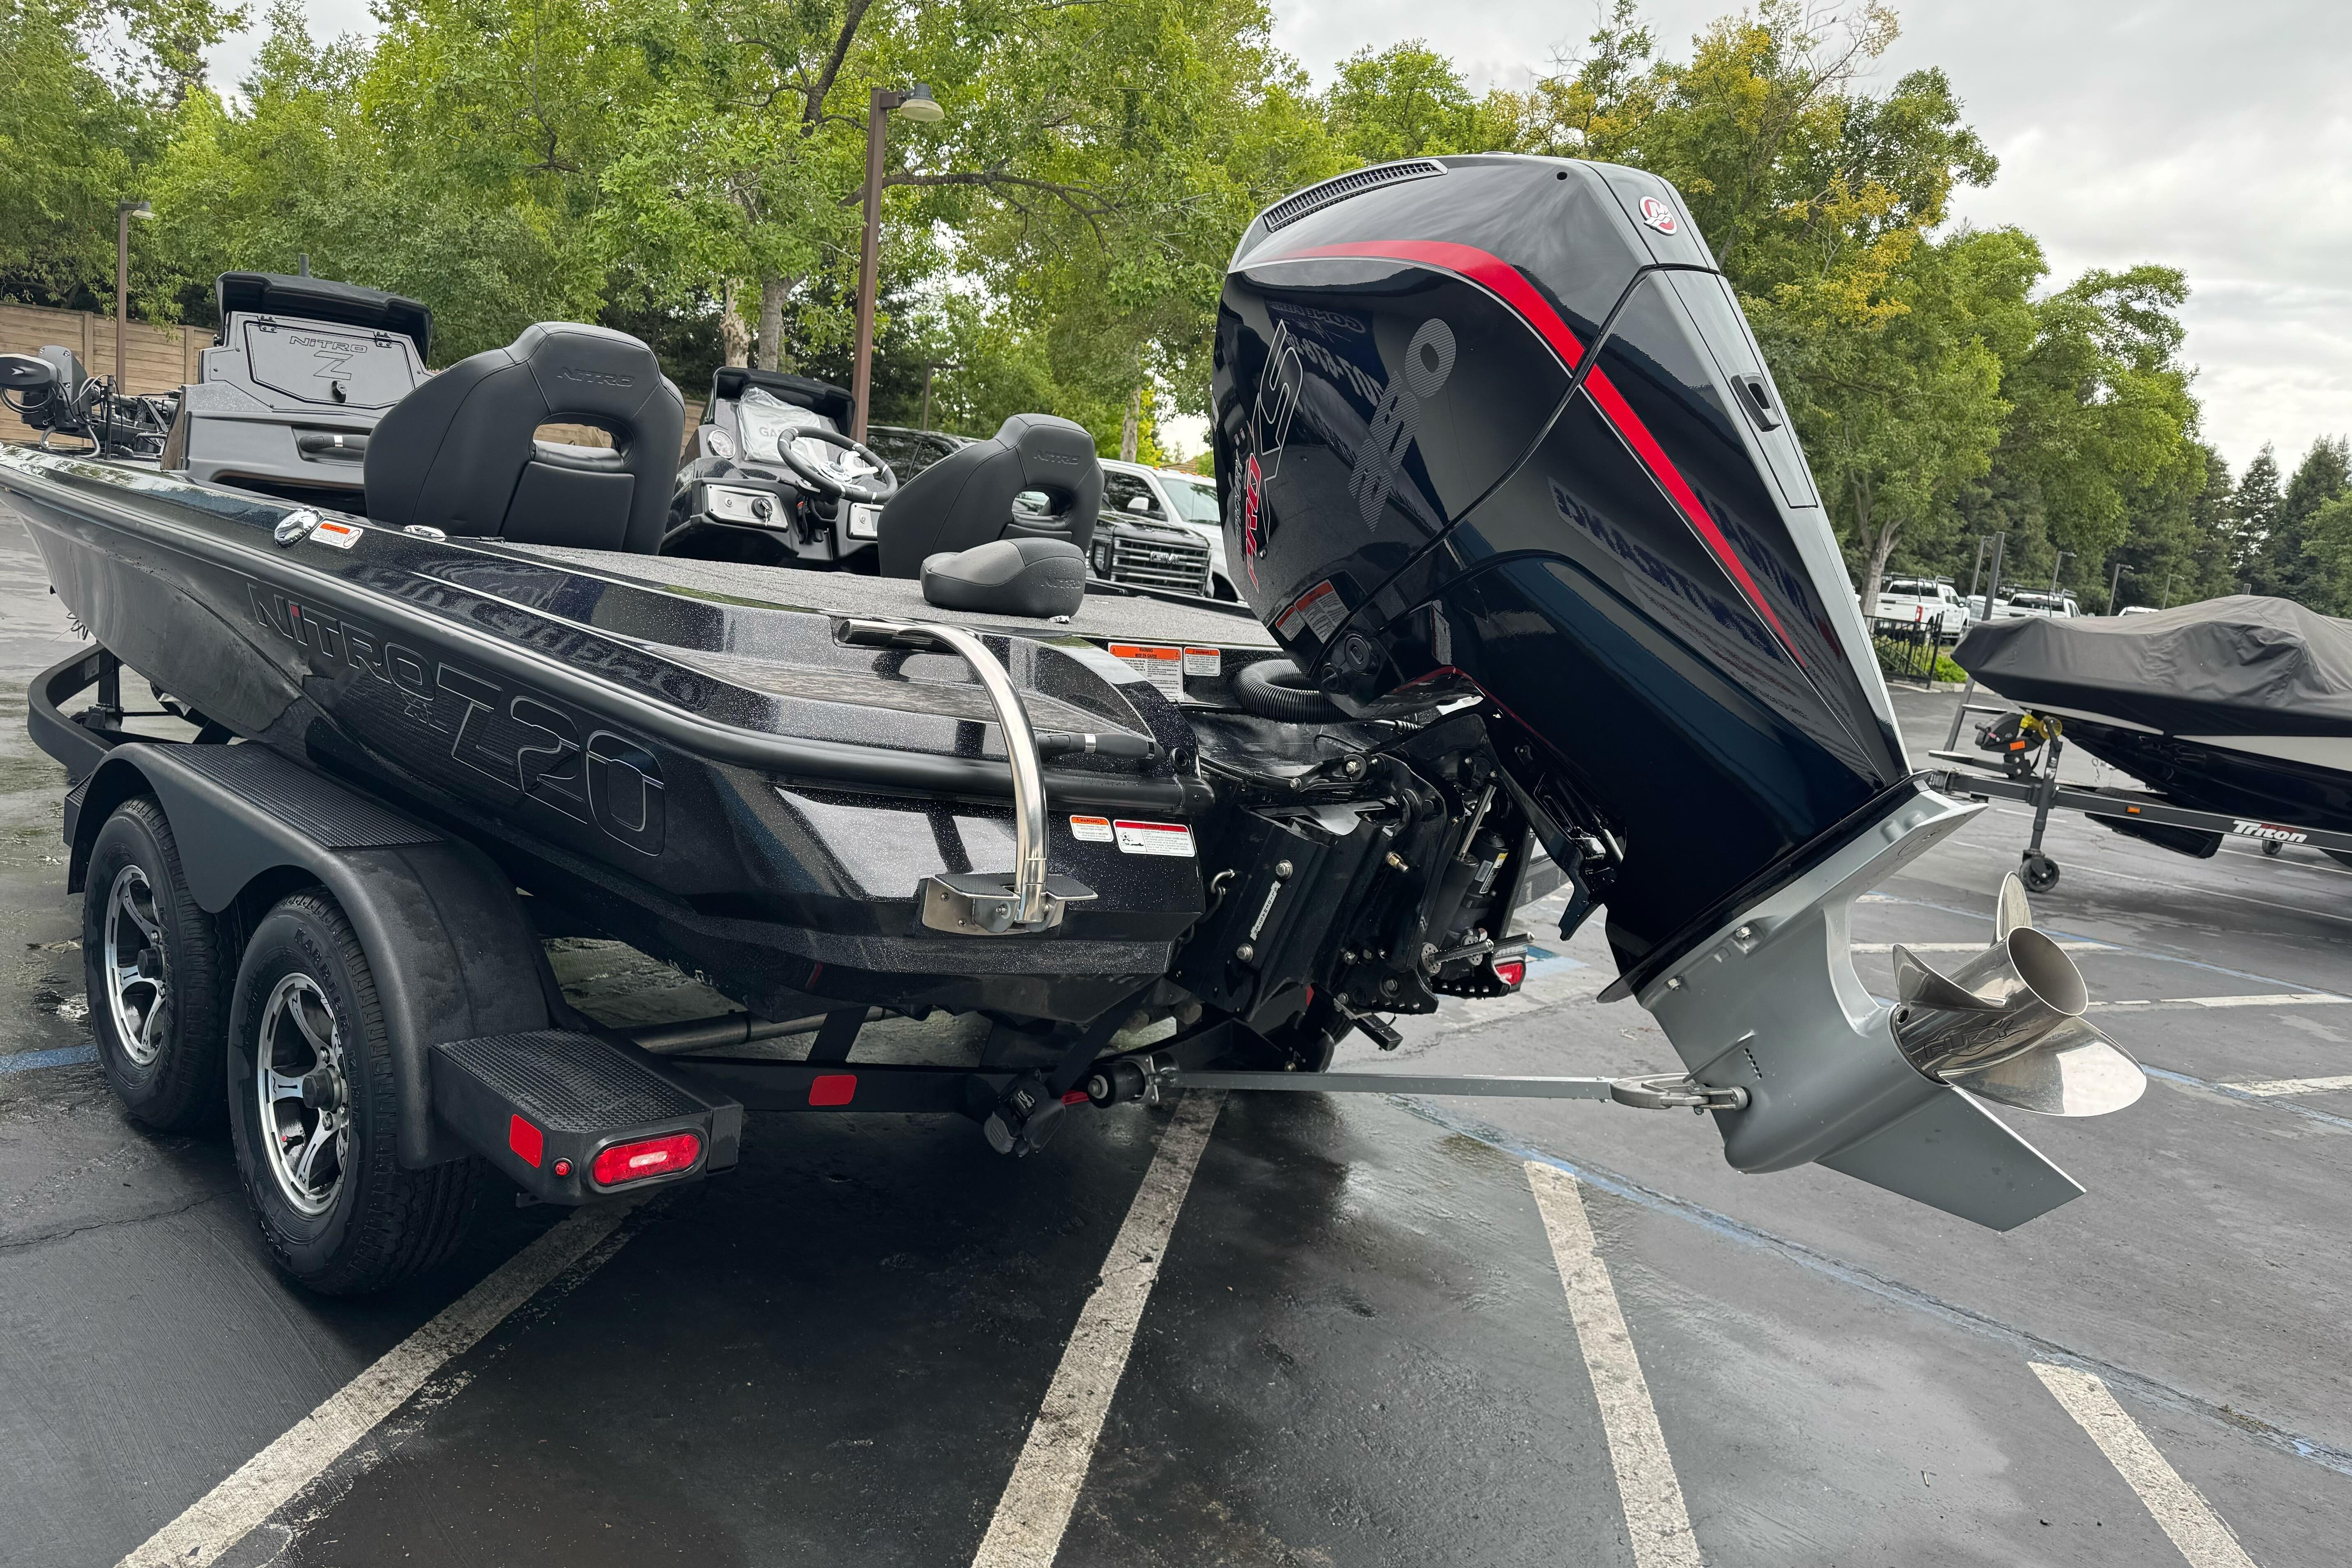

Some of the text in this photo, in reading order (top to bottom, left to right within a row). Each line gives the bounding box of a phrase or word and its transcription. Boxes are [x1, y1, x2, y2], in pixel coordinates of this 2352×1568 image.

[313, 350, 354, 380] Z
[1244, 319, 1302, 594] PRO XS
[1348, 318, 1456, 533] 250
[1150, 551, 1188, 565] GMC
[2233, 819, 2308, 843] Triton
[294, 928, 351, 1031] KARRIER
